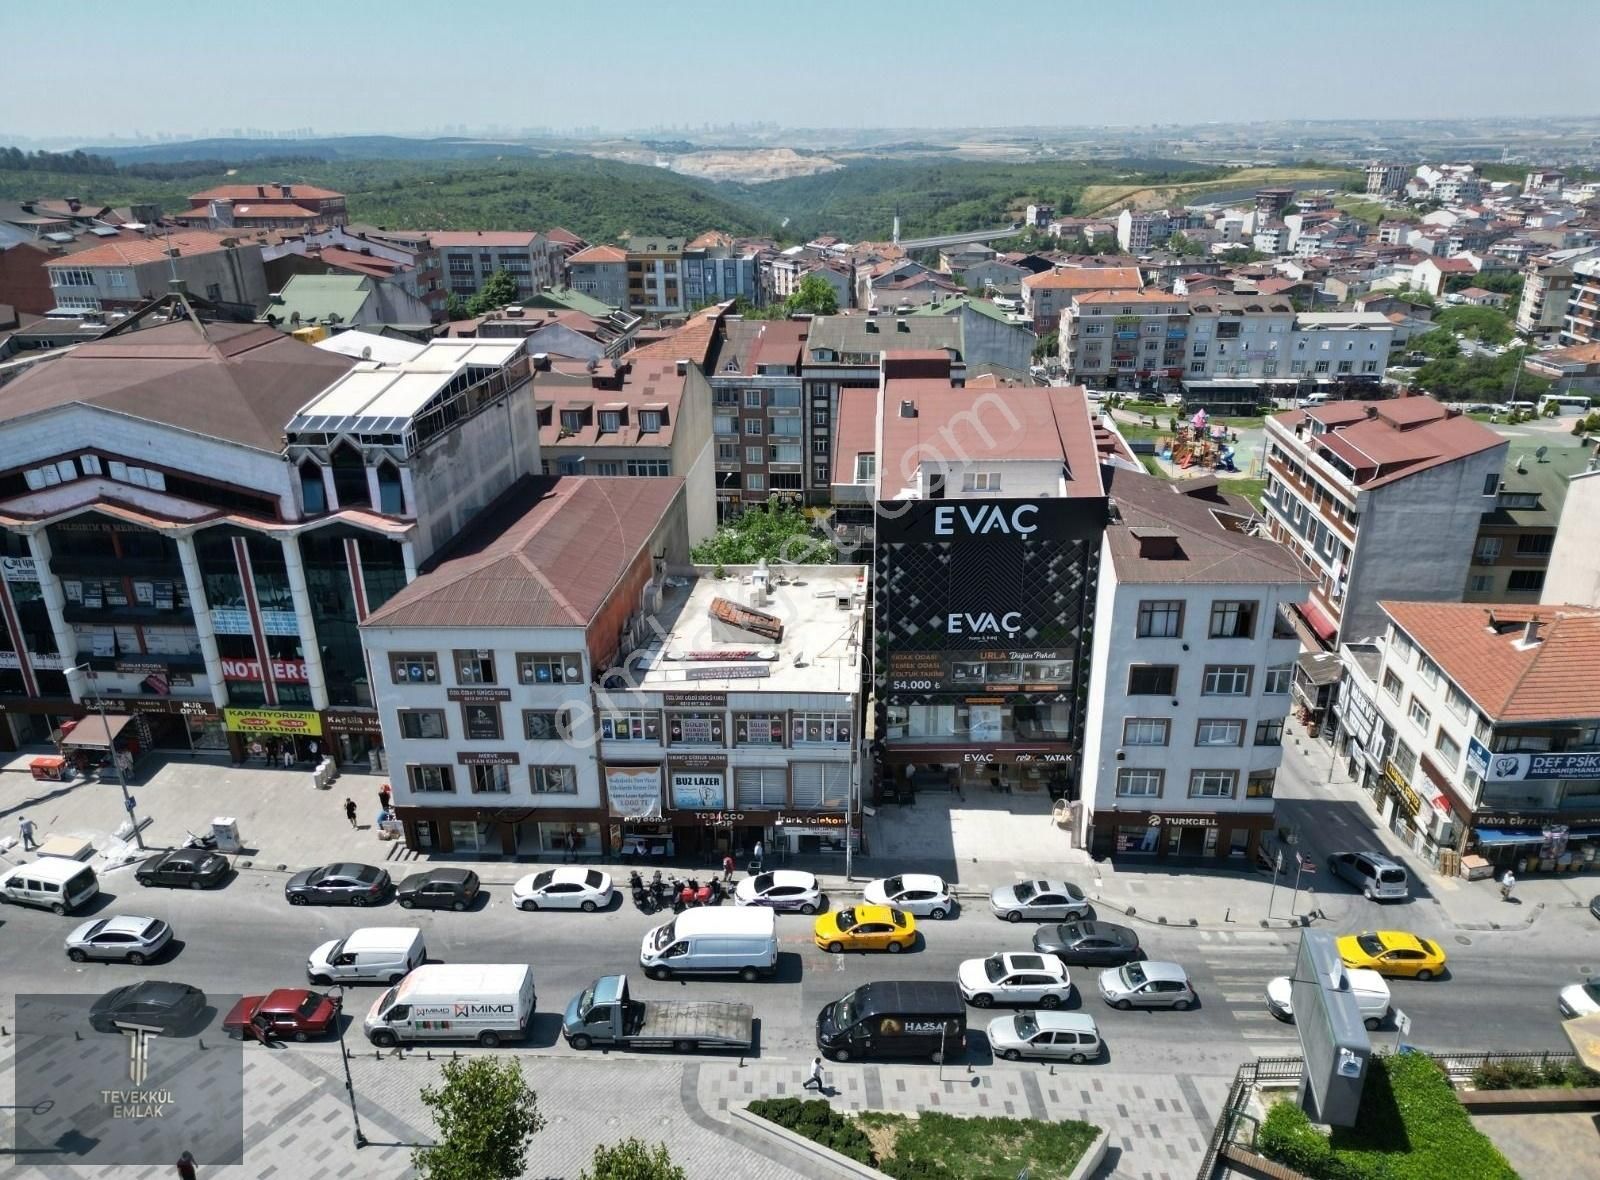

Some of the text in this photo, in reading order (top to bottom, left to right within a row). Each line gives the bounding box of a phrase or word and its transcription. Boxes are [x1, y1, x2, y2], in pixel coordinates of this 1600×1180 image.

[934, 504, 1039, 540] EVAÇ
[947, 612, 1022, 639] EVAÇ
[980, 652, 1006, 660] URLA
[893, 680, 932, 690] 54.000
[229, 710, 315, 720] KAPATIYORUZ!!!
[964, 753, 994, 763] EVAÇ
[1044, 754, 1073, 762] YATAK
[1533, 755, 1600, 768] DEF PSİK
[1550, 767, 1600, 775] DANIŞMANLI
[676, 777, 720, 786] BUZ LAZER
[695, 812, 745, 822] TOBACCO
[1164, 817, 1218, 826] TURKCELL
[1478, 816, 1506, 826] KAYA
[471, 1004, 514, 1013] MIMO
